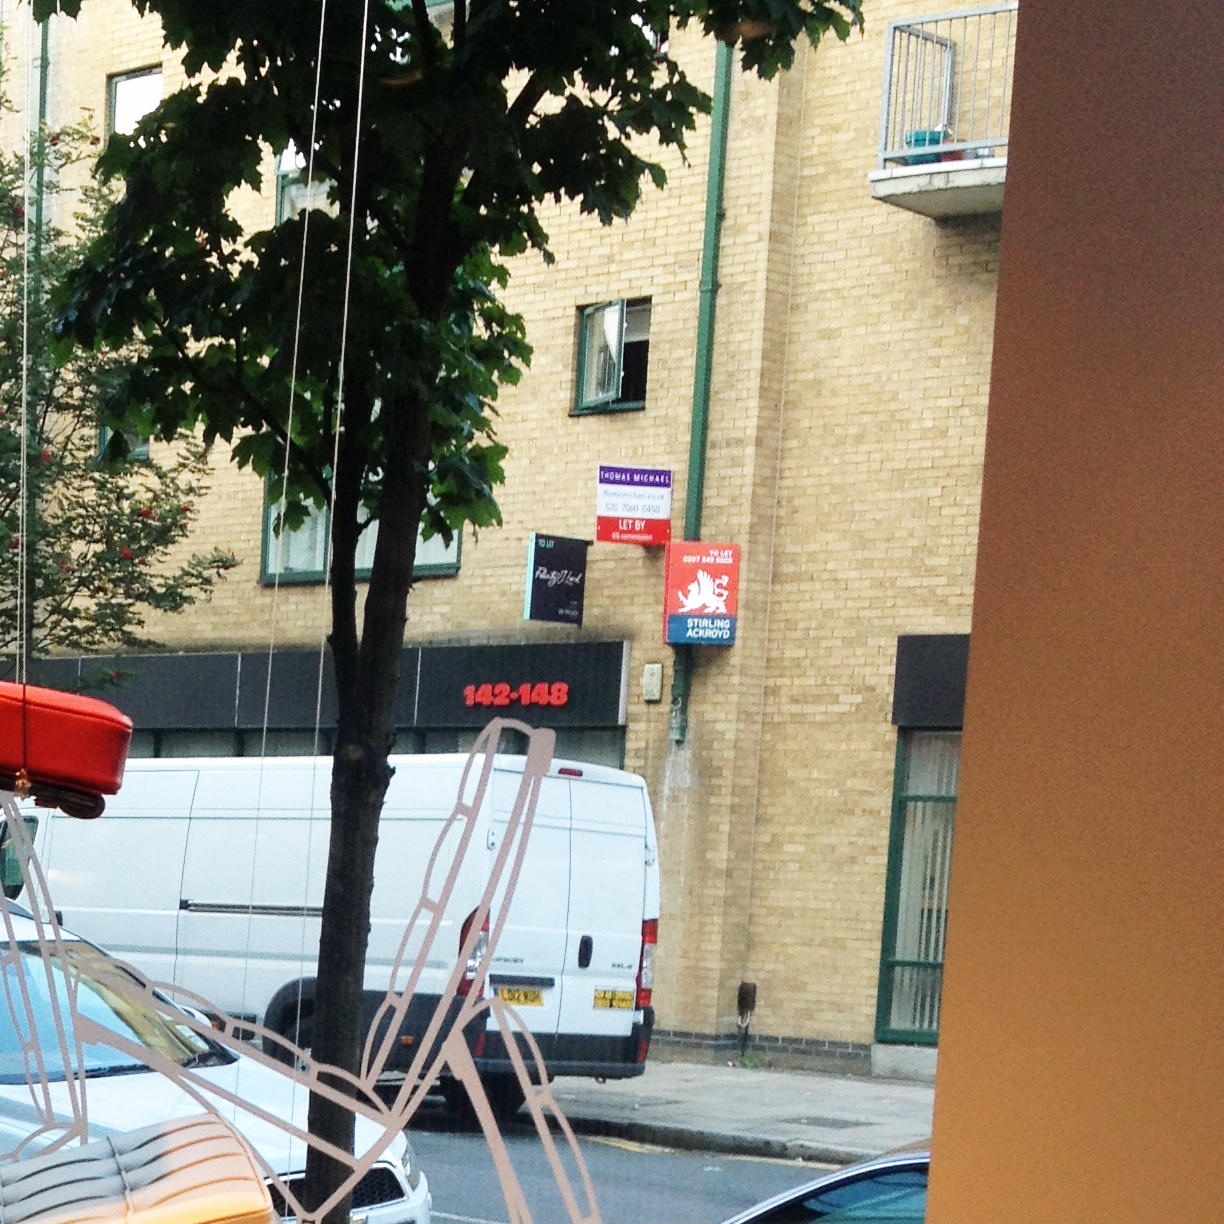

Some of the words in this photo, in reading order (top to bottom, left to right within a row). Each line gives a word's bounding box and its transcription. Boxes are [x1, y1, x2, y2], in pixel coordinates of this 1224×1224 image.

[600, 471, 631, 482] THOMAS
[633, 474, 670, 484] MICHAEL
[618, 519, 633, 530] LET
[634, 519, 647, 531] BY
[709, 549, 719, 557] TO
[720, 549, 733, 557] LET
[686, 617, 731, 629] STIRLING
[686, 628, 731, 639] ACKROYD
